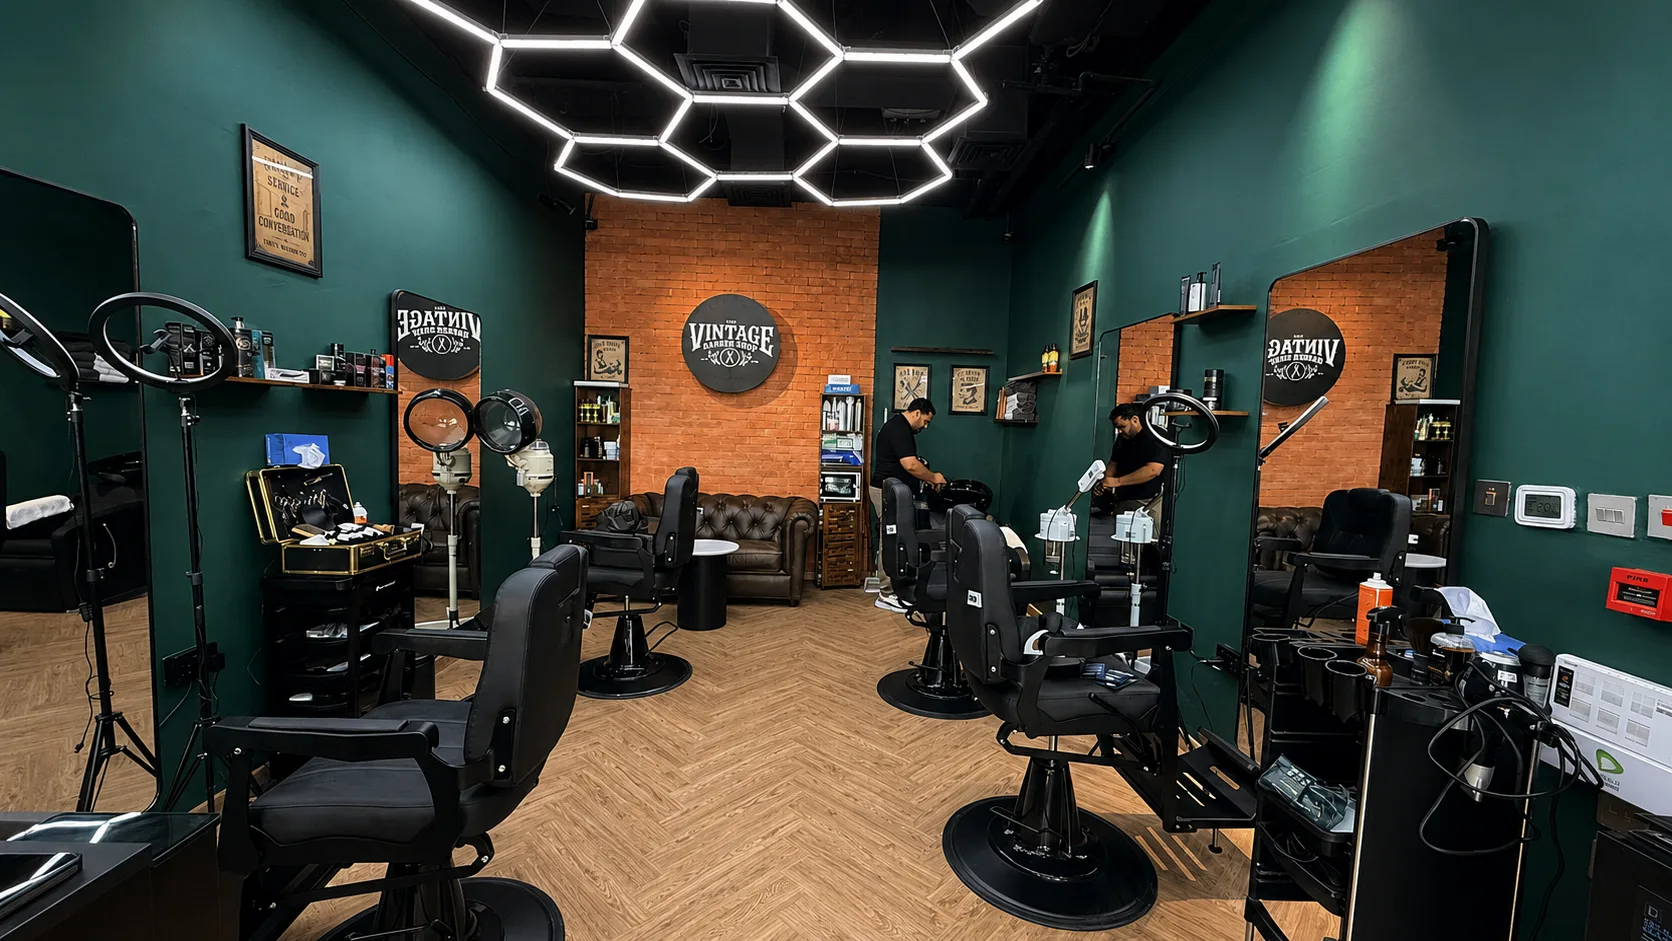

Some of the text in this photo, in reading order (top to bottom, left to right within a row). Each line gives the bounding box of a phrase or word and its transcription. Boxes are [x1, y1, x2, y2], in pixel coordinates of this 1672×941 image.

[267, 175, 301, 198] SERVICE
[274, 207, 296, 225] GOOD
[688, 322, 775, 358] VINTAGE
